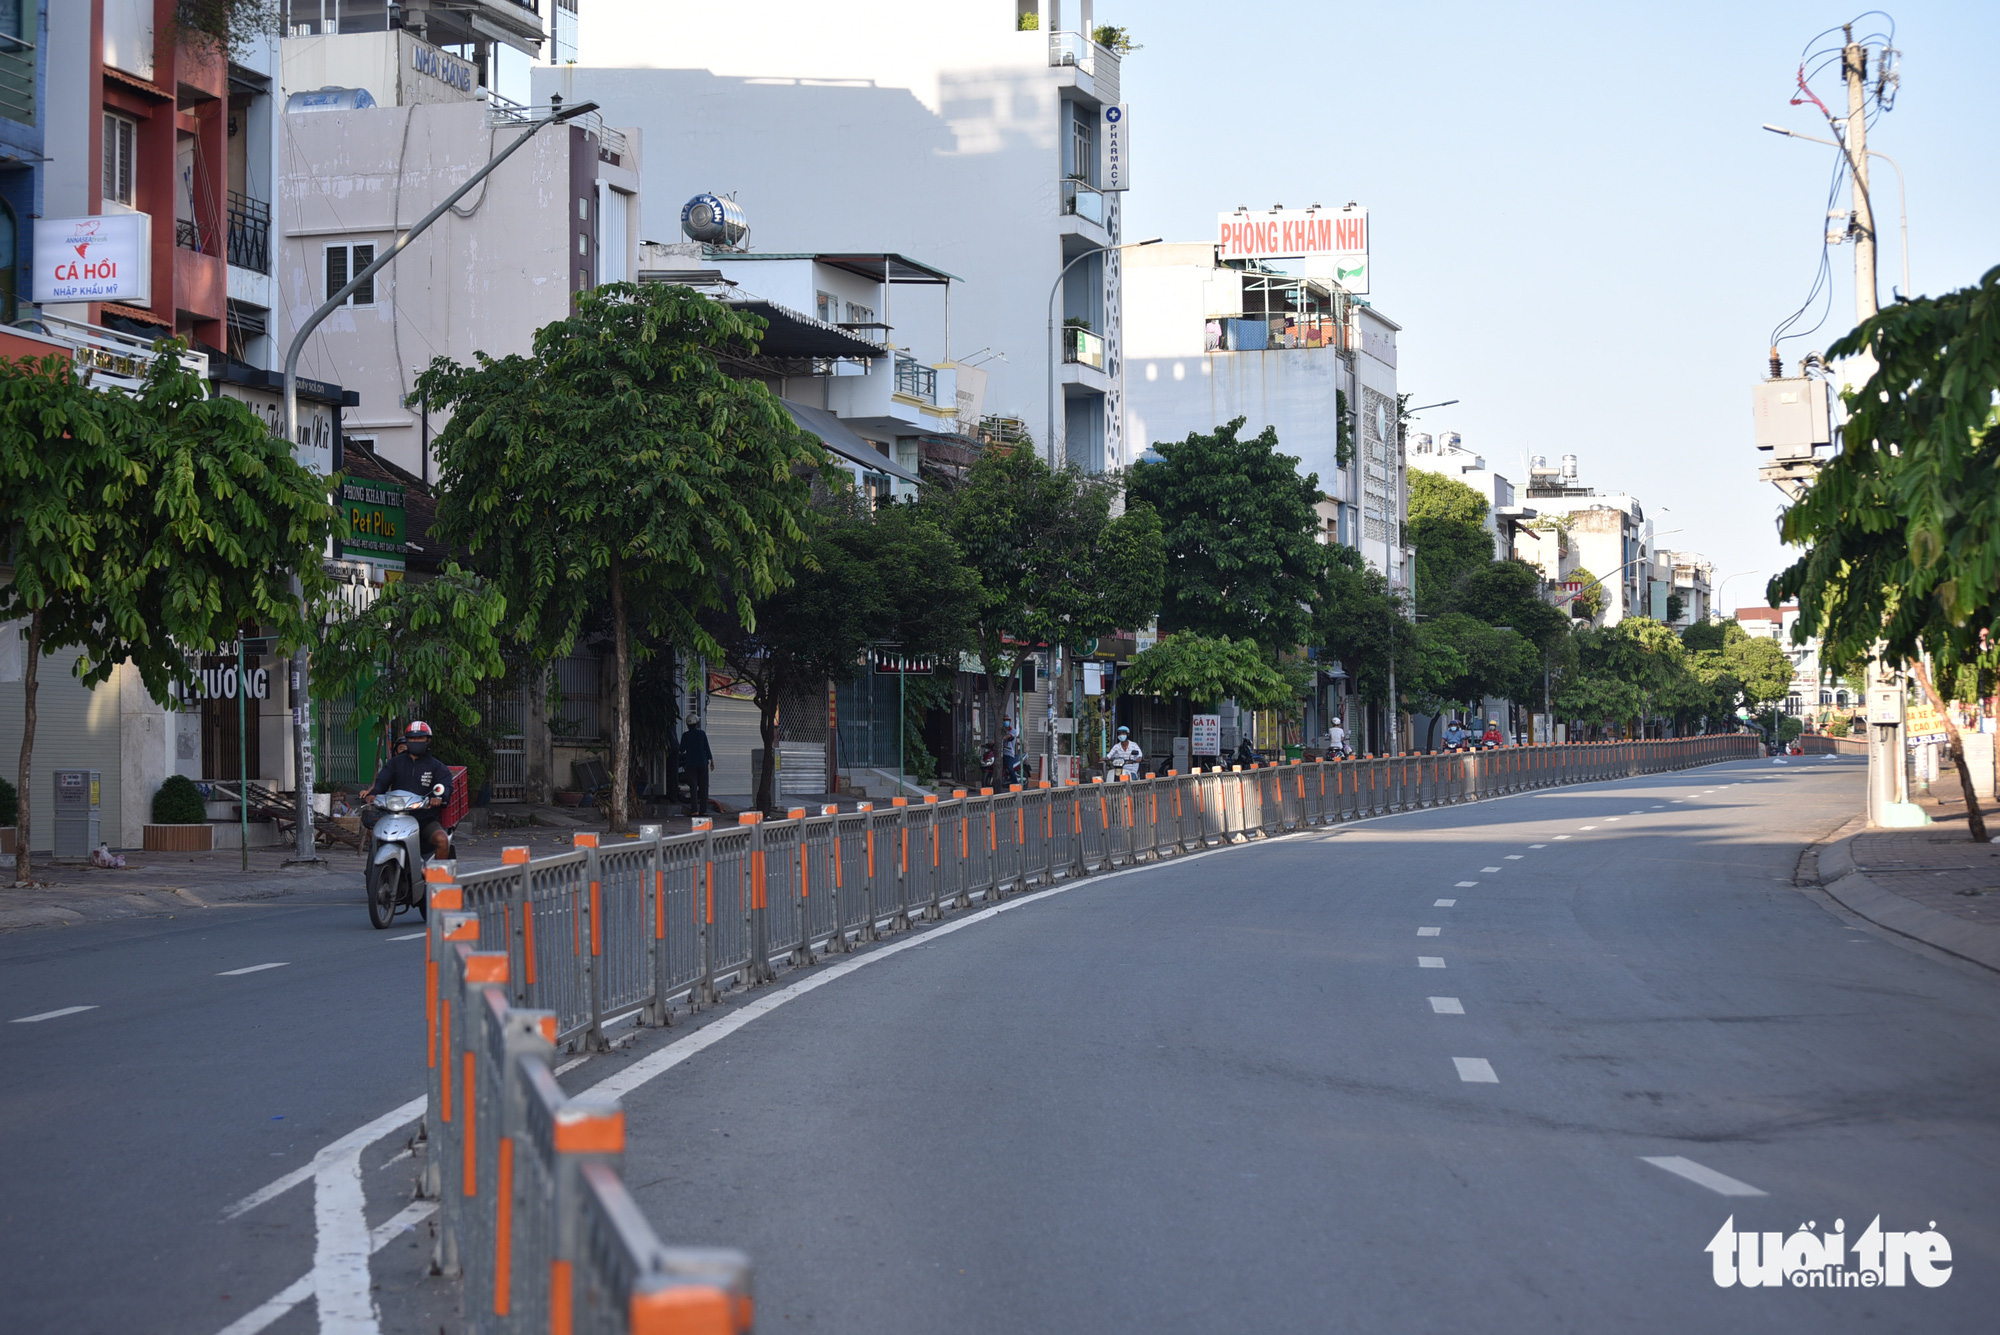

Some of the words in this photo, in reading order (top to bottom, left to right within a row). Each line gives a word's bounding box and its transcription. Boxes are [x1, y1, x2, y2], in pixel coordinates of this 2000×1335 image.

[1110, 124, 1119, 187] PHARMACY
[1221, 213, 1278, 255] PHÒNG
[1283, 212, 1331, 252] KHÁM
[1336, 218, 1364, 250] NHI
[54, 261, 79, 281] CÁ
[84, 258, 116, 279] HỒI
[53, 286, 78, 298] NHẬP
[80, 283, 103, 295] KHẨU
[106, 284, 118, 294] MỸ
[297, 424, 311, 447] am
[365, 484, 386, 505] KHÁM
[352, 508, 371, 533] Pet
[374, 511, 396, 537] Plus
[1194, 716, 1204, 726] GÀ
